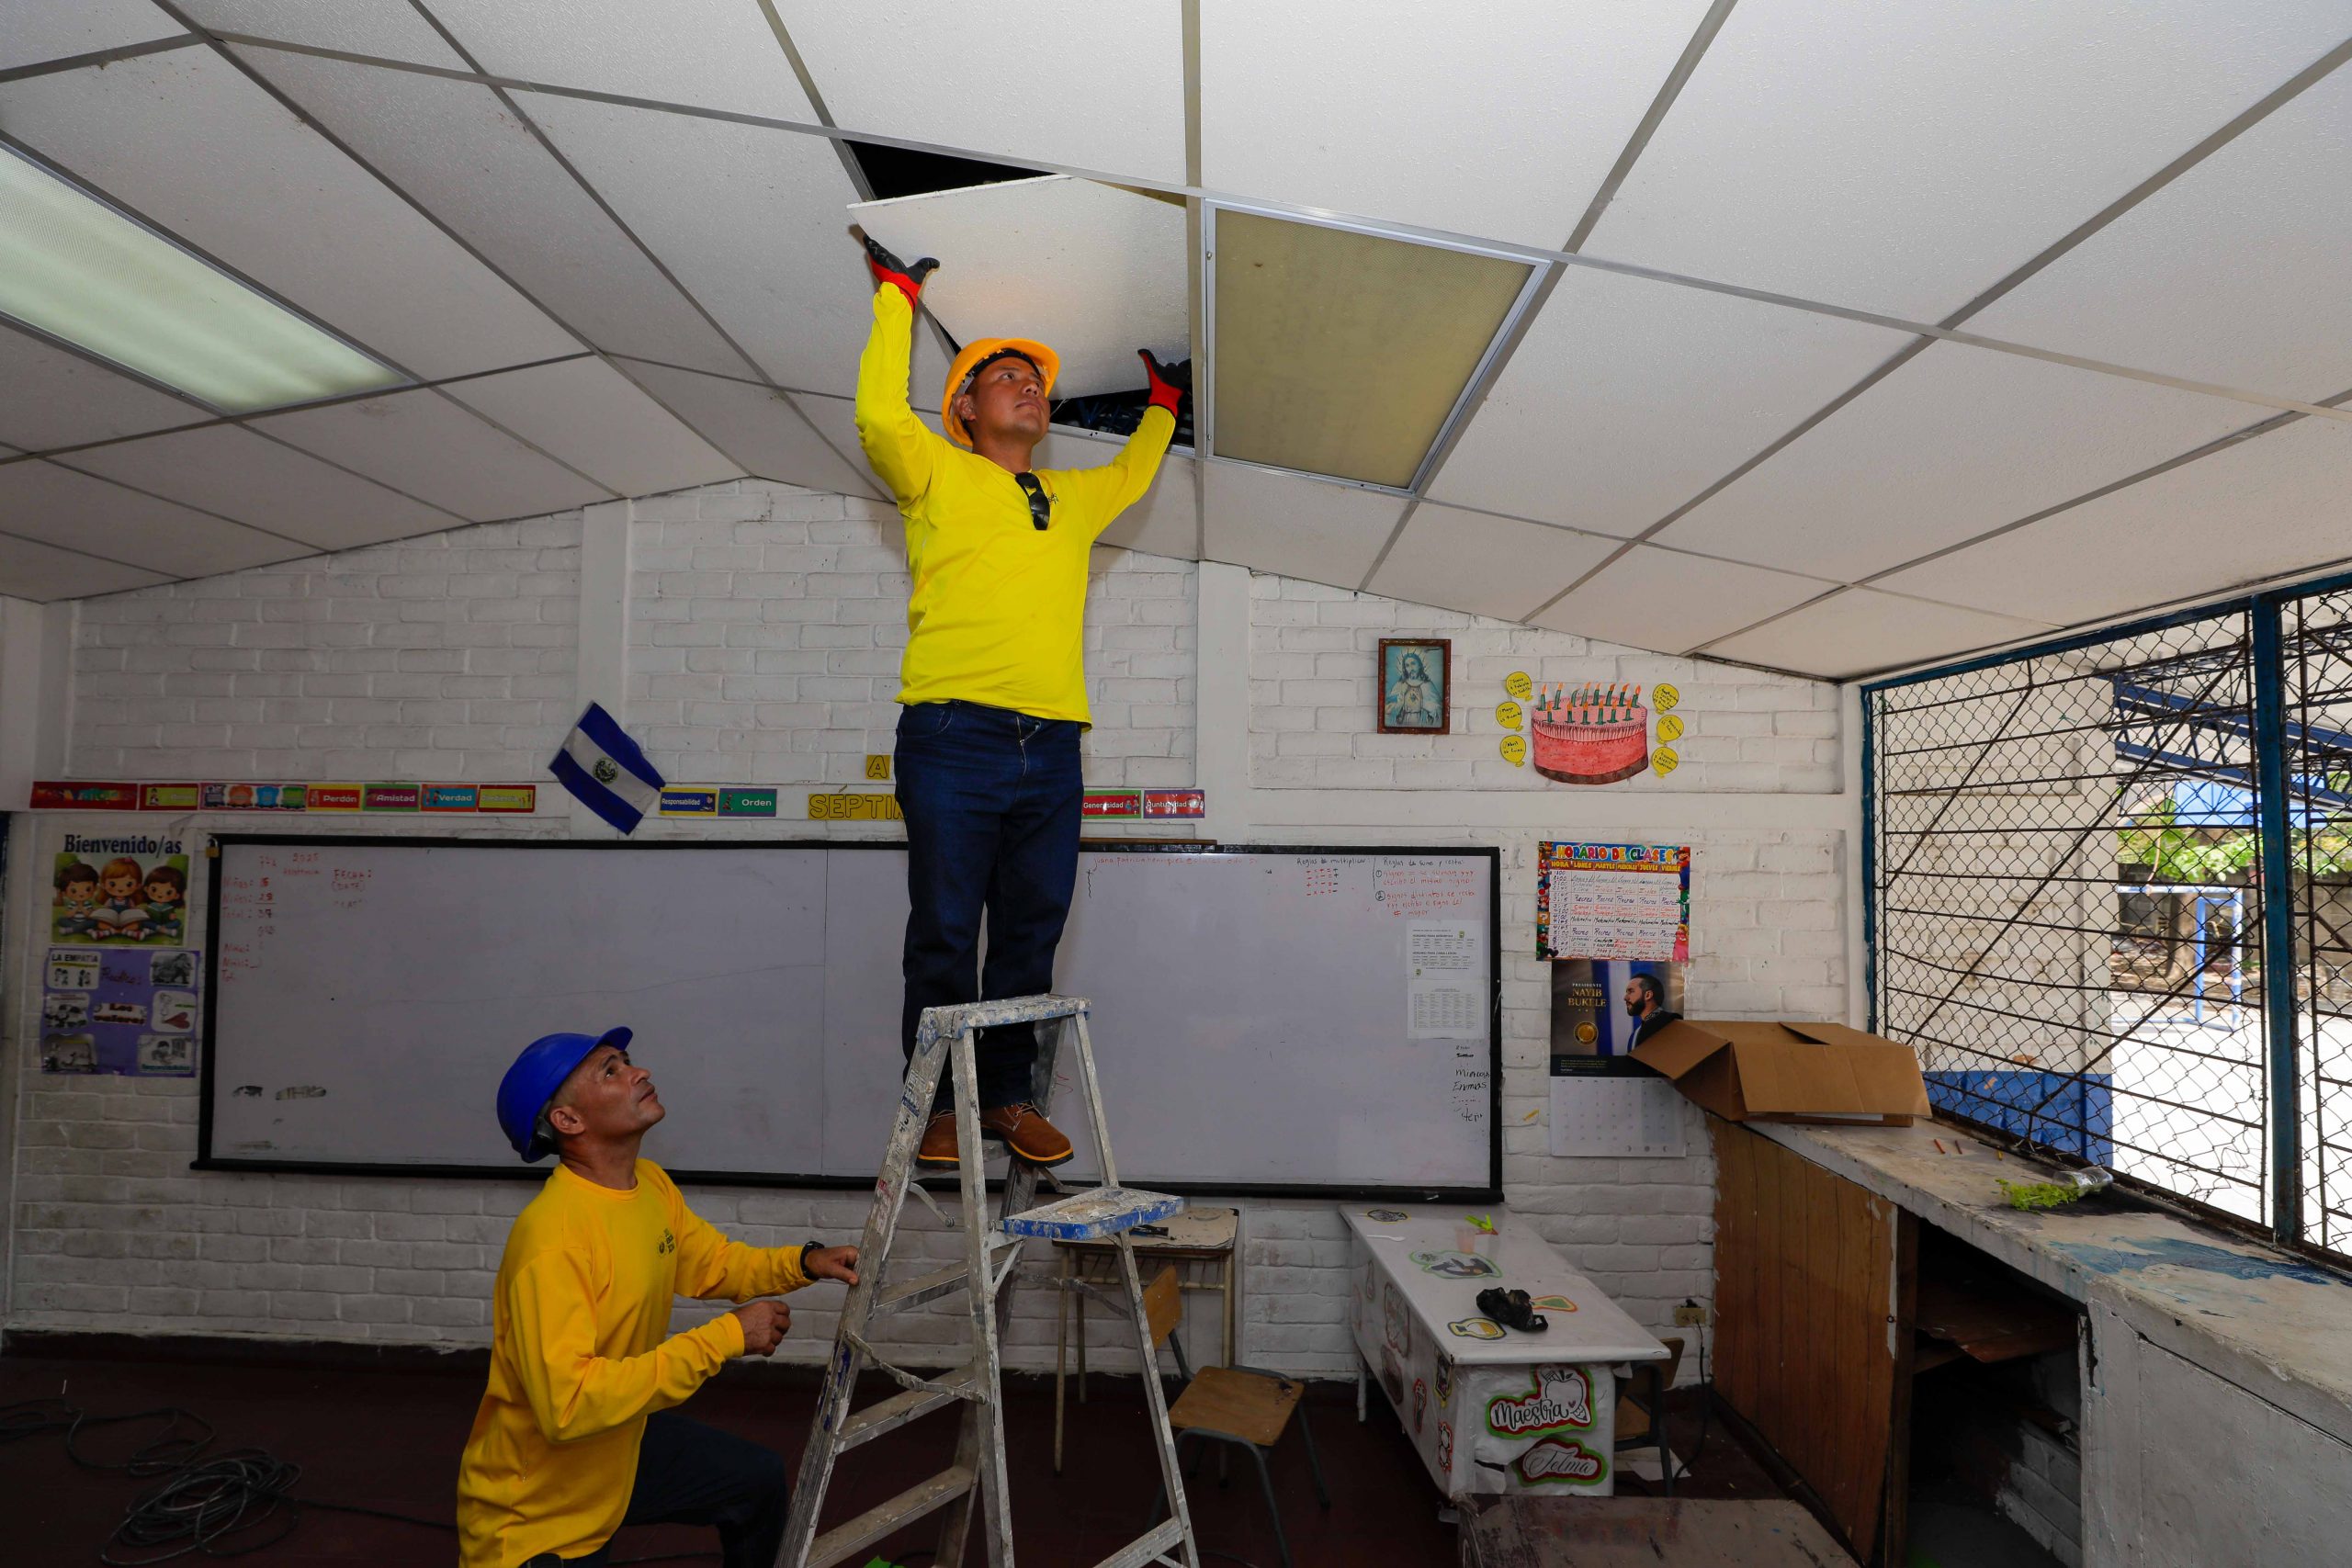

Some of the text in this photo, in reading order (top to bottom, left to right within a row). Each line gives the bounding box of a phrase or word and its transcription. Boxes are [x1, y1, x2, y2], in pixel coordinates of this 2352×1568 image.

[322, 795, 357, 804] Perdón
[375, 794, 415, 802] Amistad
[438, 794, 472, 802] Verdad
[741, 798, 773, 807] Orden
[63, 834, 182, 858] Bienvenido/as
[1556, 845, 1674, 863] HORARIO DE CLASES
[1572, 988, 1602, 997] NAYIB
[1567, 998, 1607, 1007] BUKELE
[1495, 1399, 1569, 1429] Maestra
